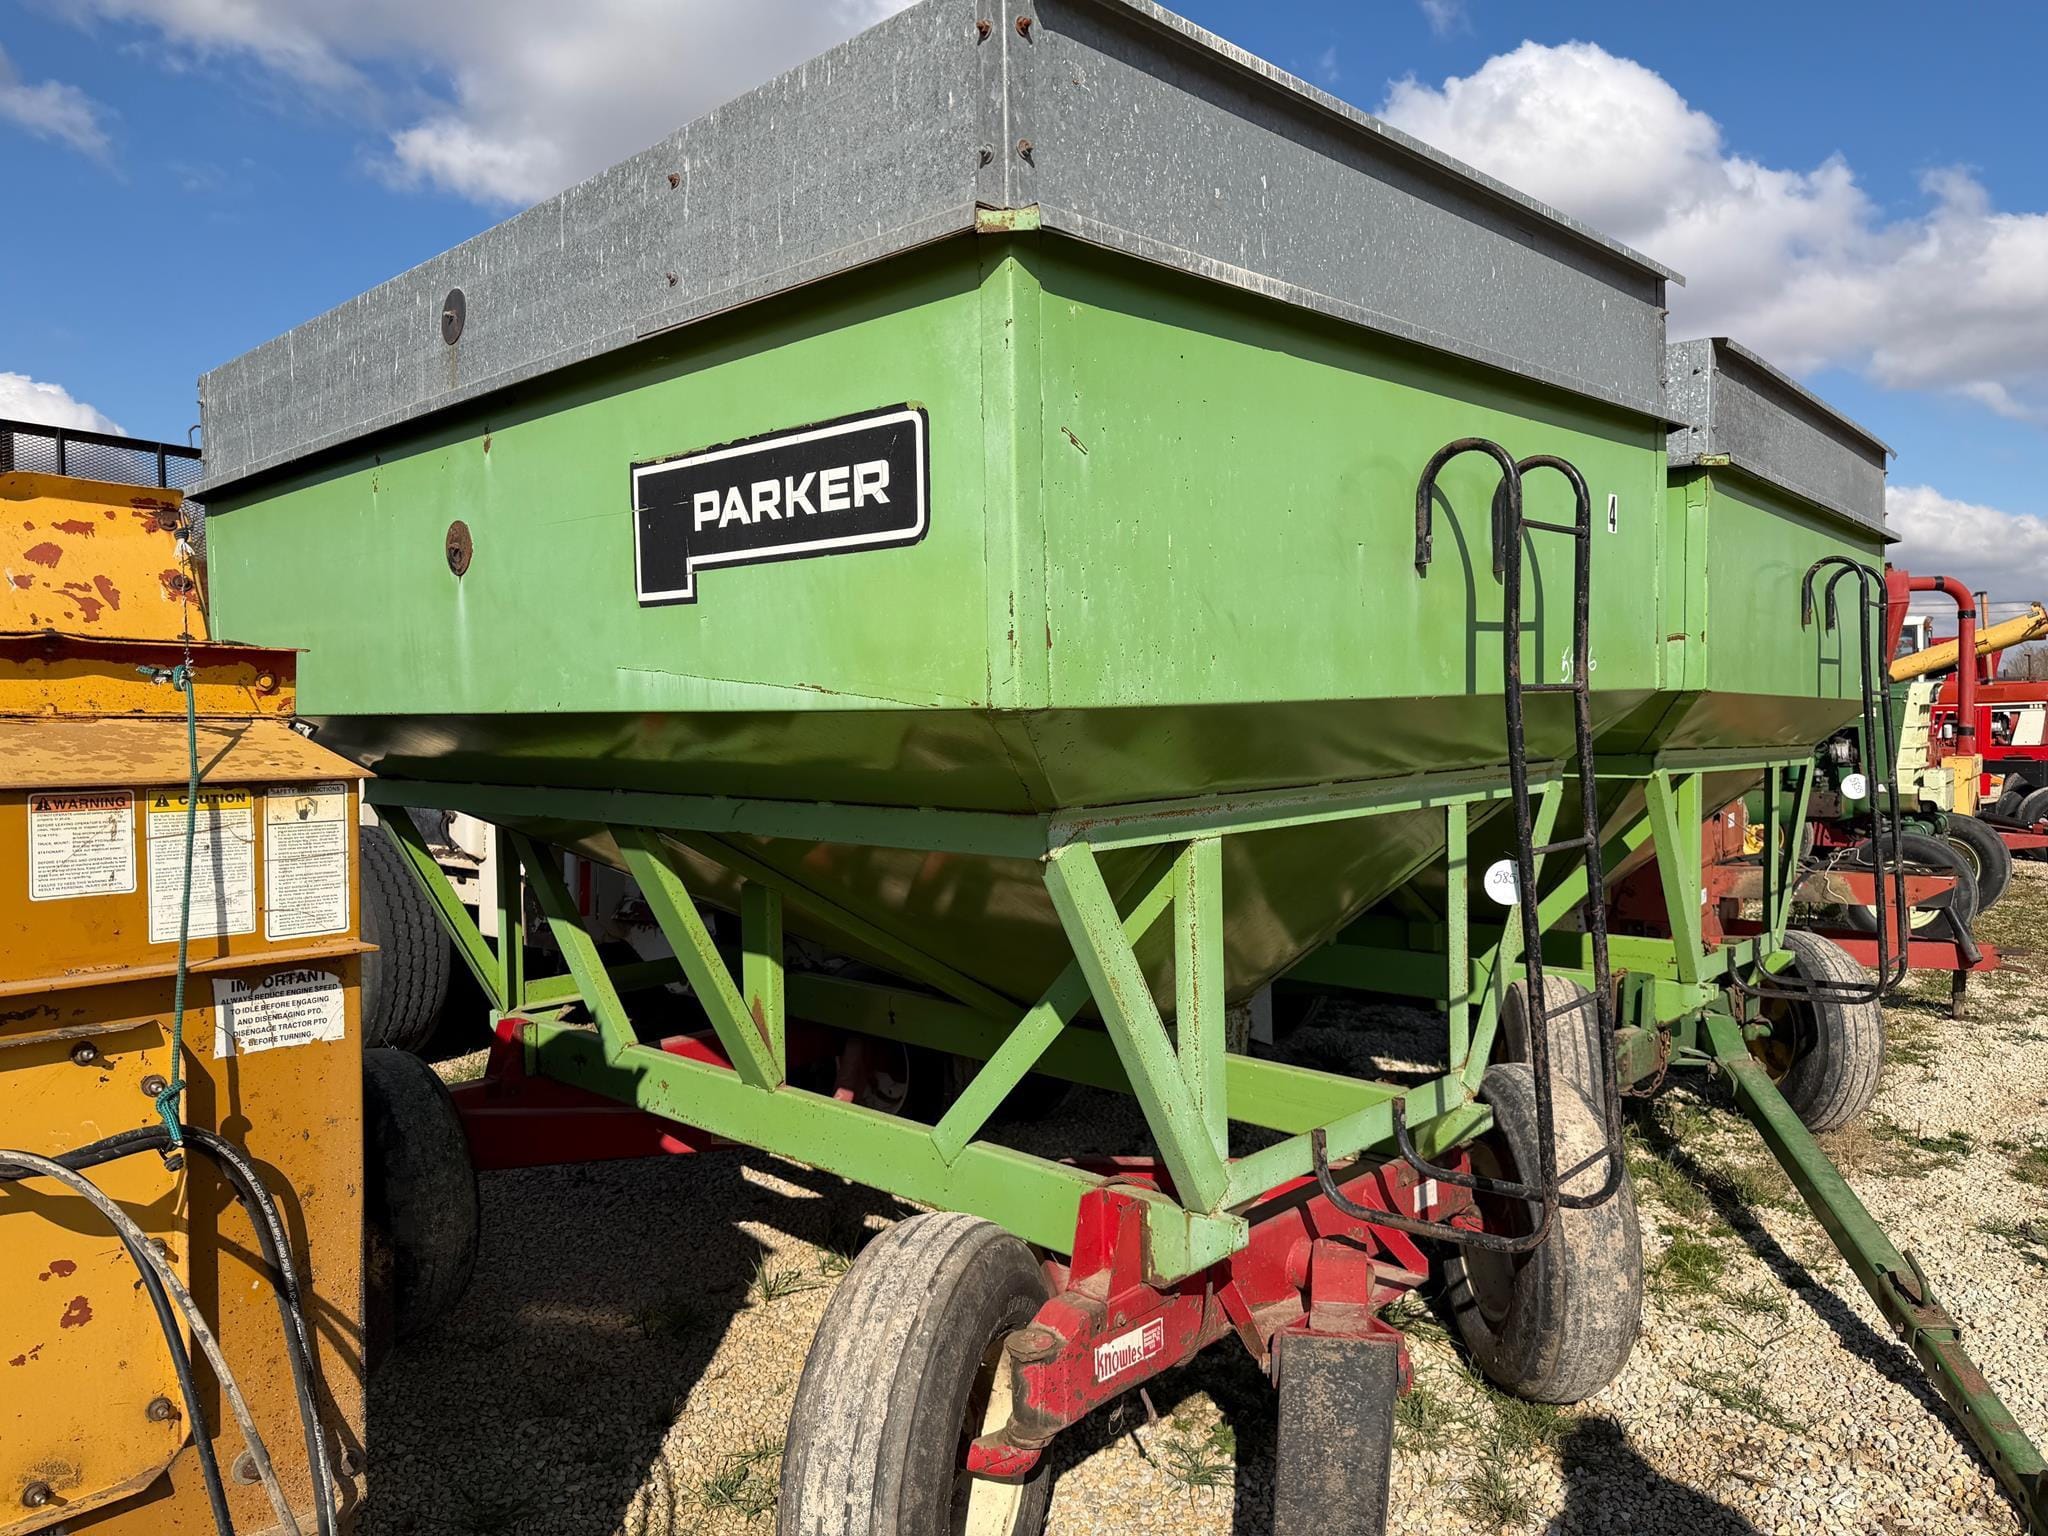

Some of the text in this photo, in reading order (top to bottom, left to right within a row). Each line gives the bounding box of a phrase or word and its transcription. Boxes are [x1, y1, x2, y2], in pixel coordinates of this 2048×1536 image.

[693, 459, 890, 532] PARKER
[1609, 496, 1616, 532] 4
[53, 797, 126, 810] WARNING
[178, 793, 246, 805] CUTION
[1493, 870, 1519, 884] 585
[231, 970, 326, 993] IMORTANT
[221, 983, 338, 1005] ALWAYS REDUCE ENGINE SPEED
[230, 995, 330, 1016] TO IDLE BEFORE ENGAGING
[233, 1017, 328, 1038] DISENGAGE TRACTOR PTO
[237, 1017, 254, 1026] AND
[255, 1009, 306, 1023] DISENGAGING
[248, 1035, 278, 1046] BEFORE
[239, 1162, 256, 1182] COVER
[272, 1227, 281, 1241] MPa
